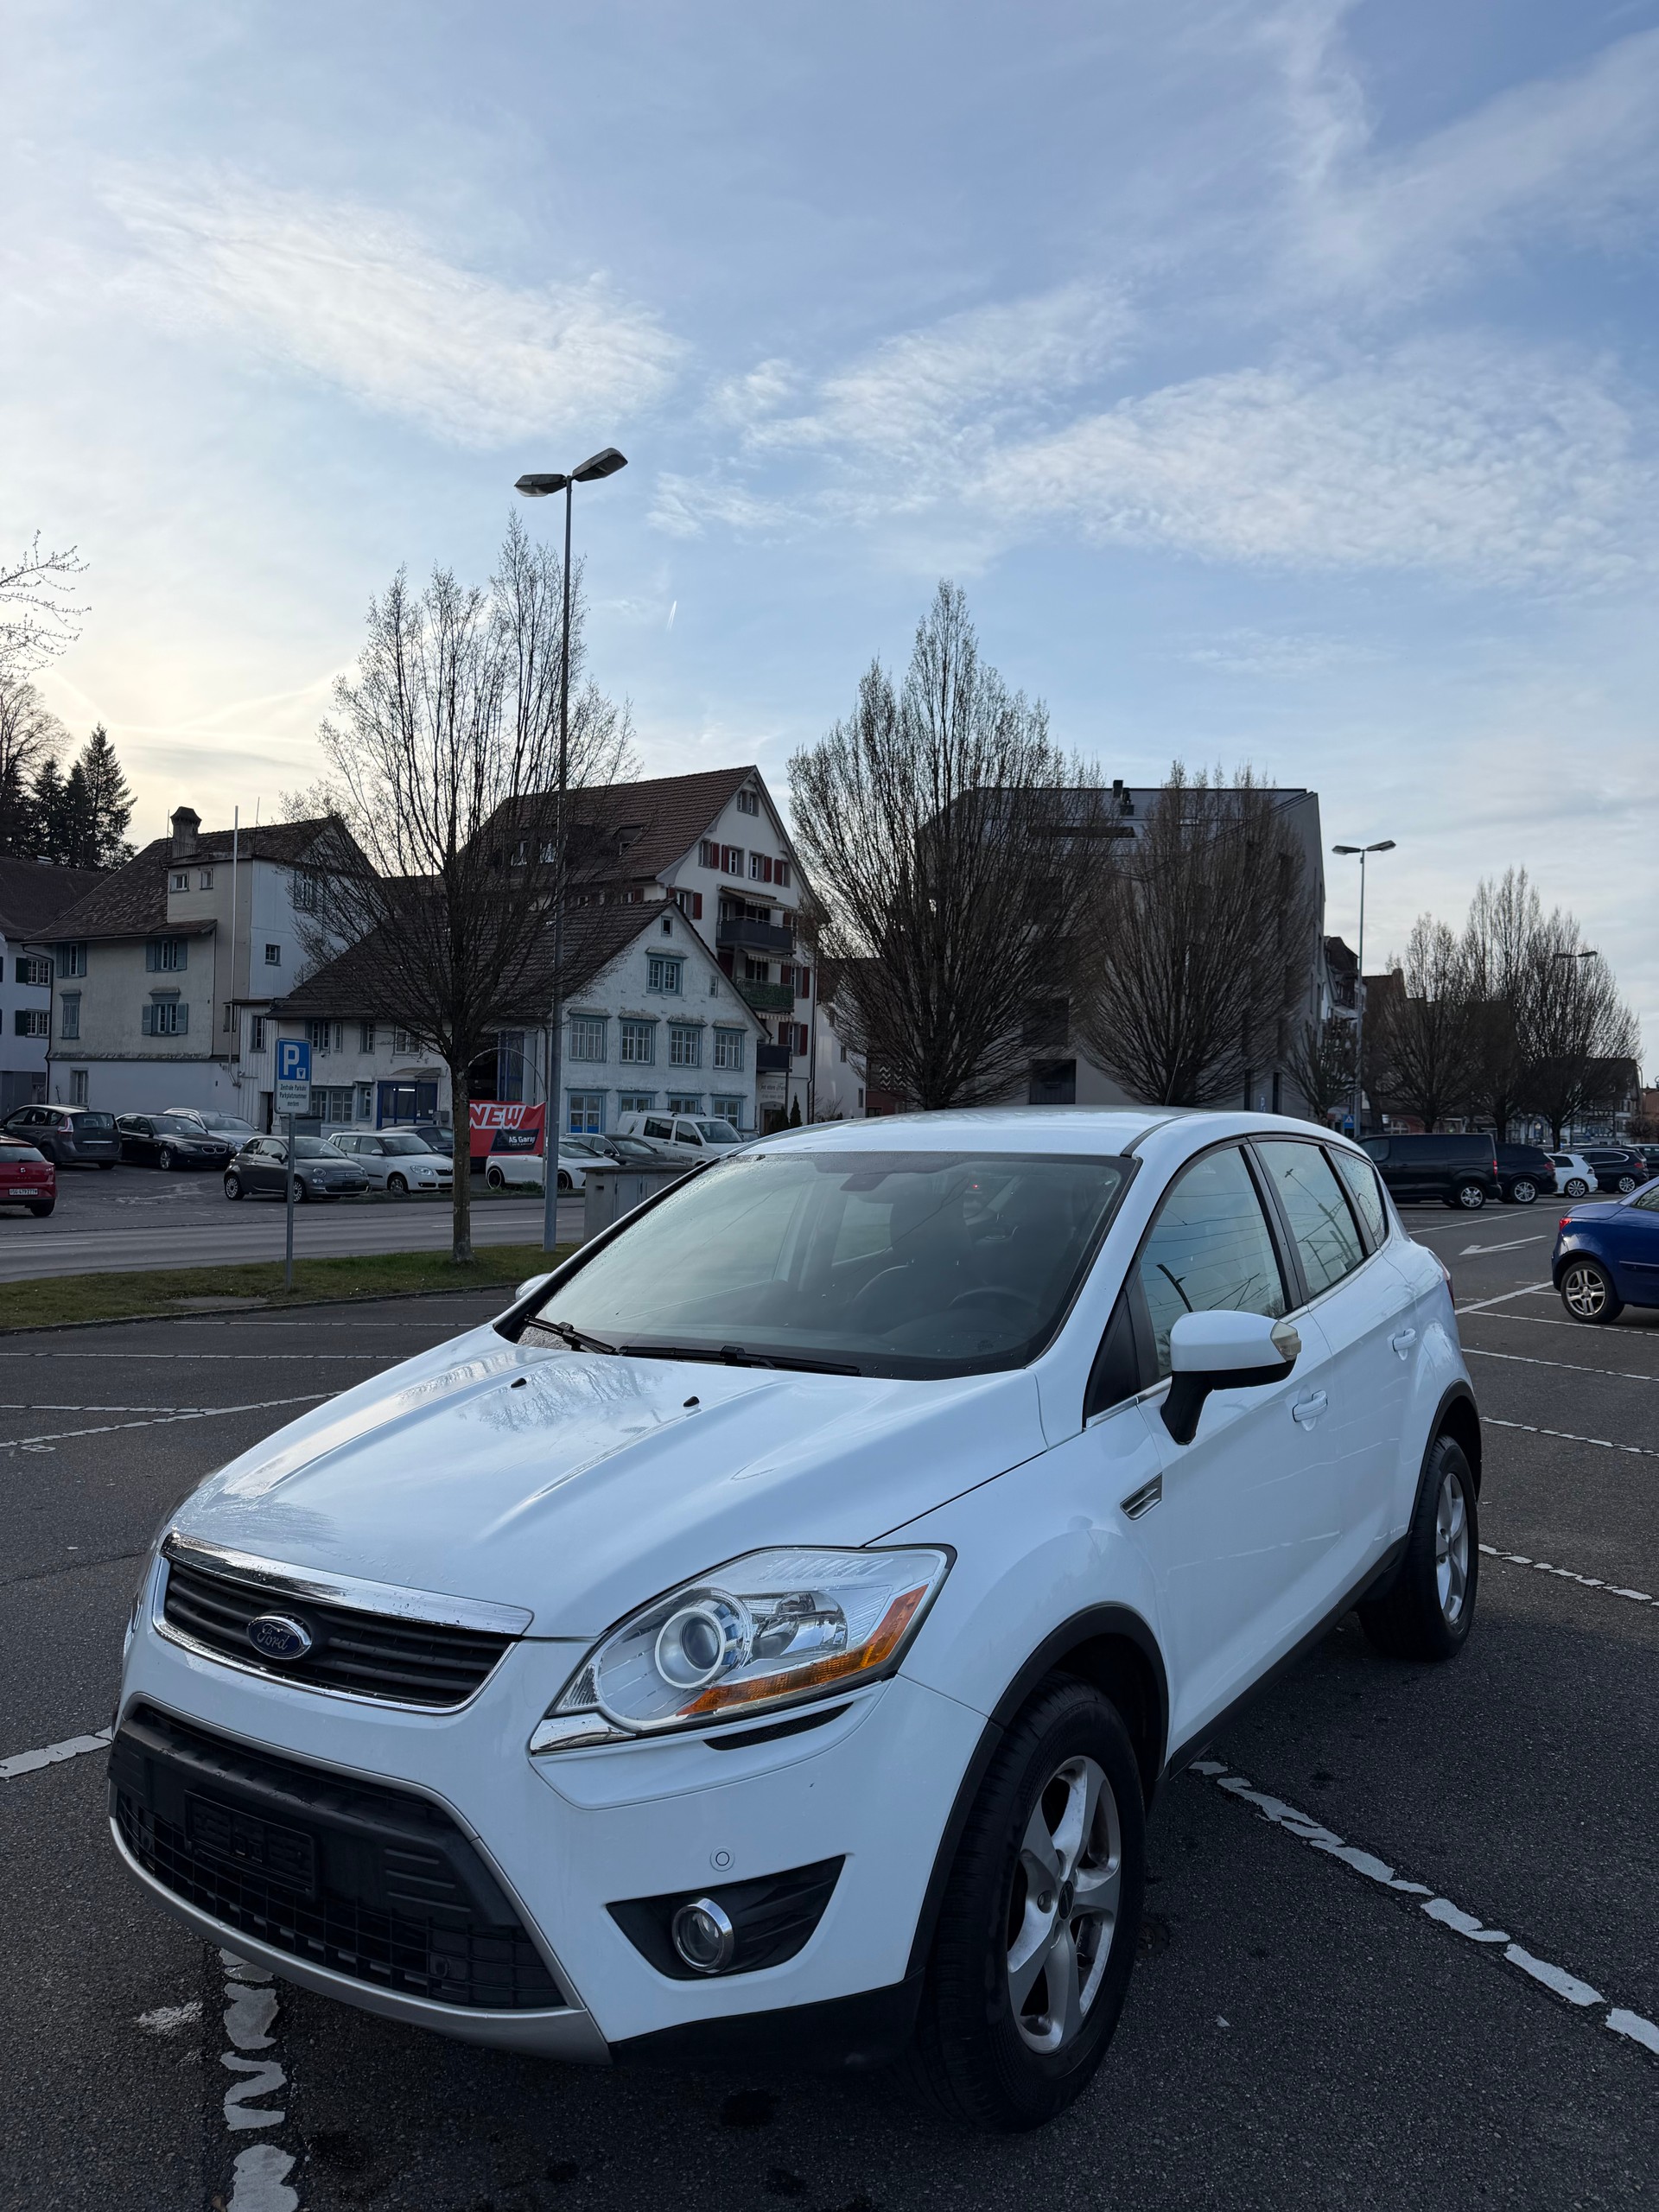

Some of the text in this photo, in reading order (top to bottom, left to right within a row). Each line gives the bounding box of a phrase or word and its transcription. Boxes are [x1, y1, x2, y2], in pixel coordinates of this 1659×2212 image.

[283, 1044, 300, 1076] P
[469, 1103, 526, 1129] NEW
[257, 1624, 290, 1650] Ford
